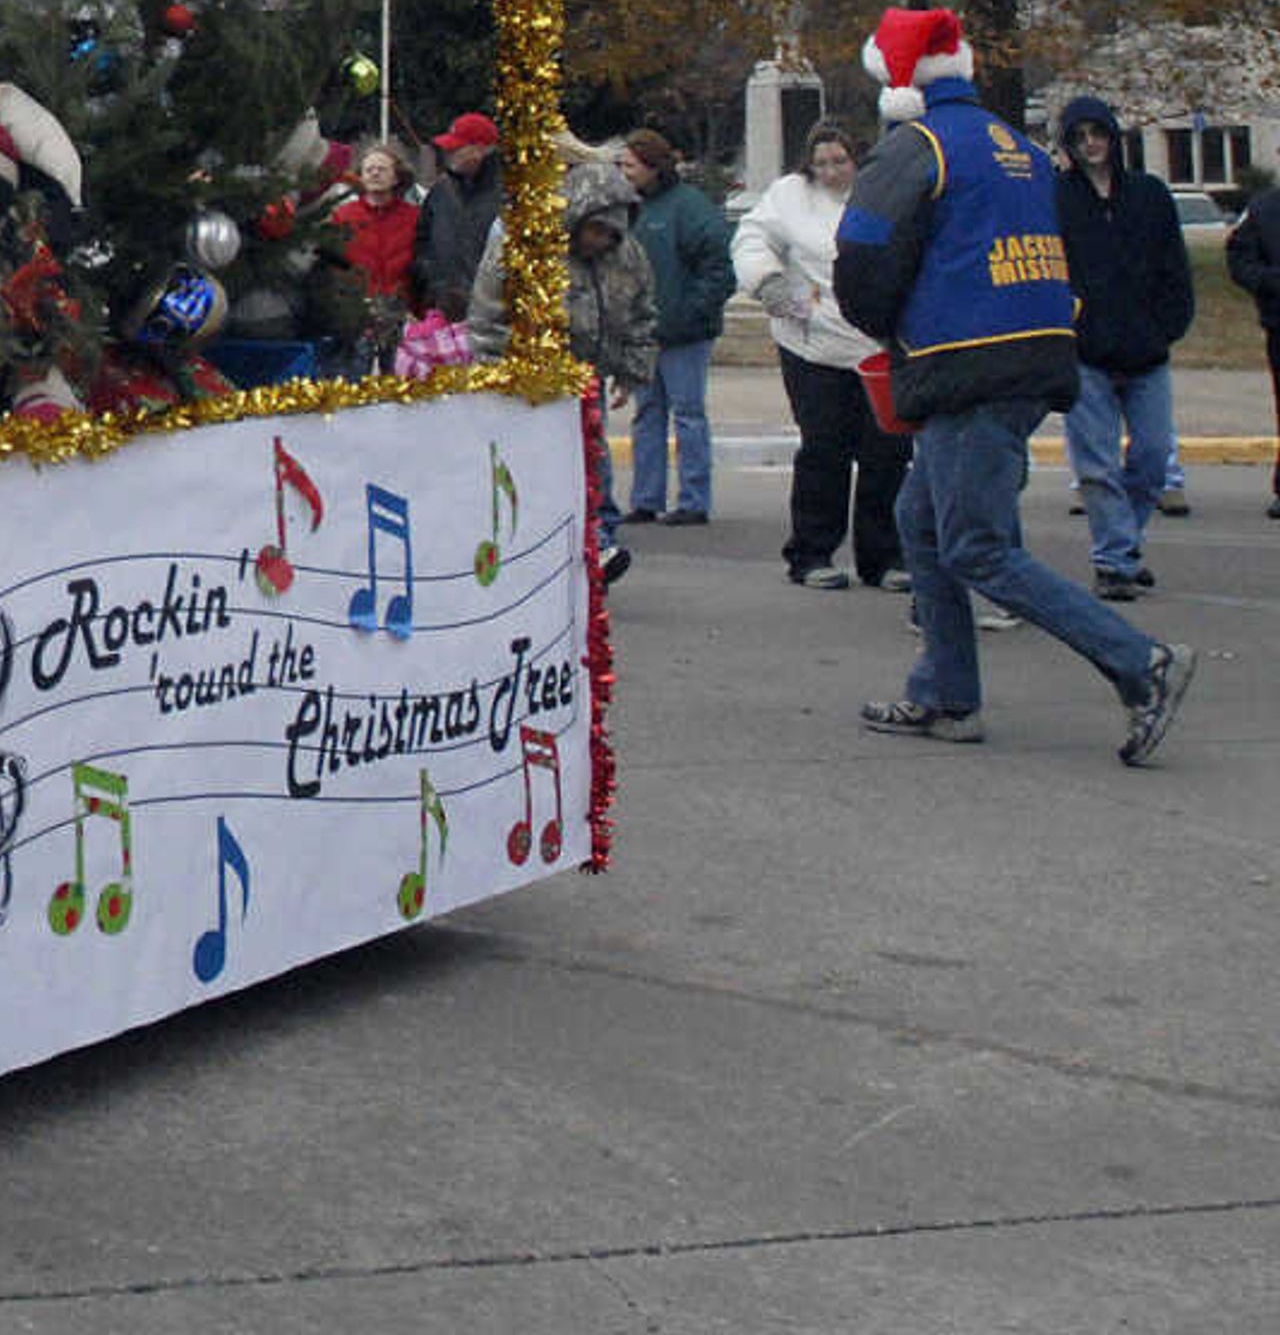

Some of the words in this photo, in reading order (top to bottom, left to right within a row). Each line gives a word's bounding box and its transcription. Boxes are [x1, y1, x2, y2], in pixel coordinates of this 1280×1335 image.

[31, 547, 250, 692] Rockin'
[267, 623, 317, 688] the
[285, 678, 481, 799] Christmas
[489, 637, 575, 753] Tree
